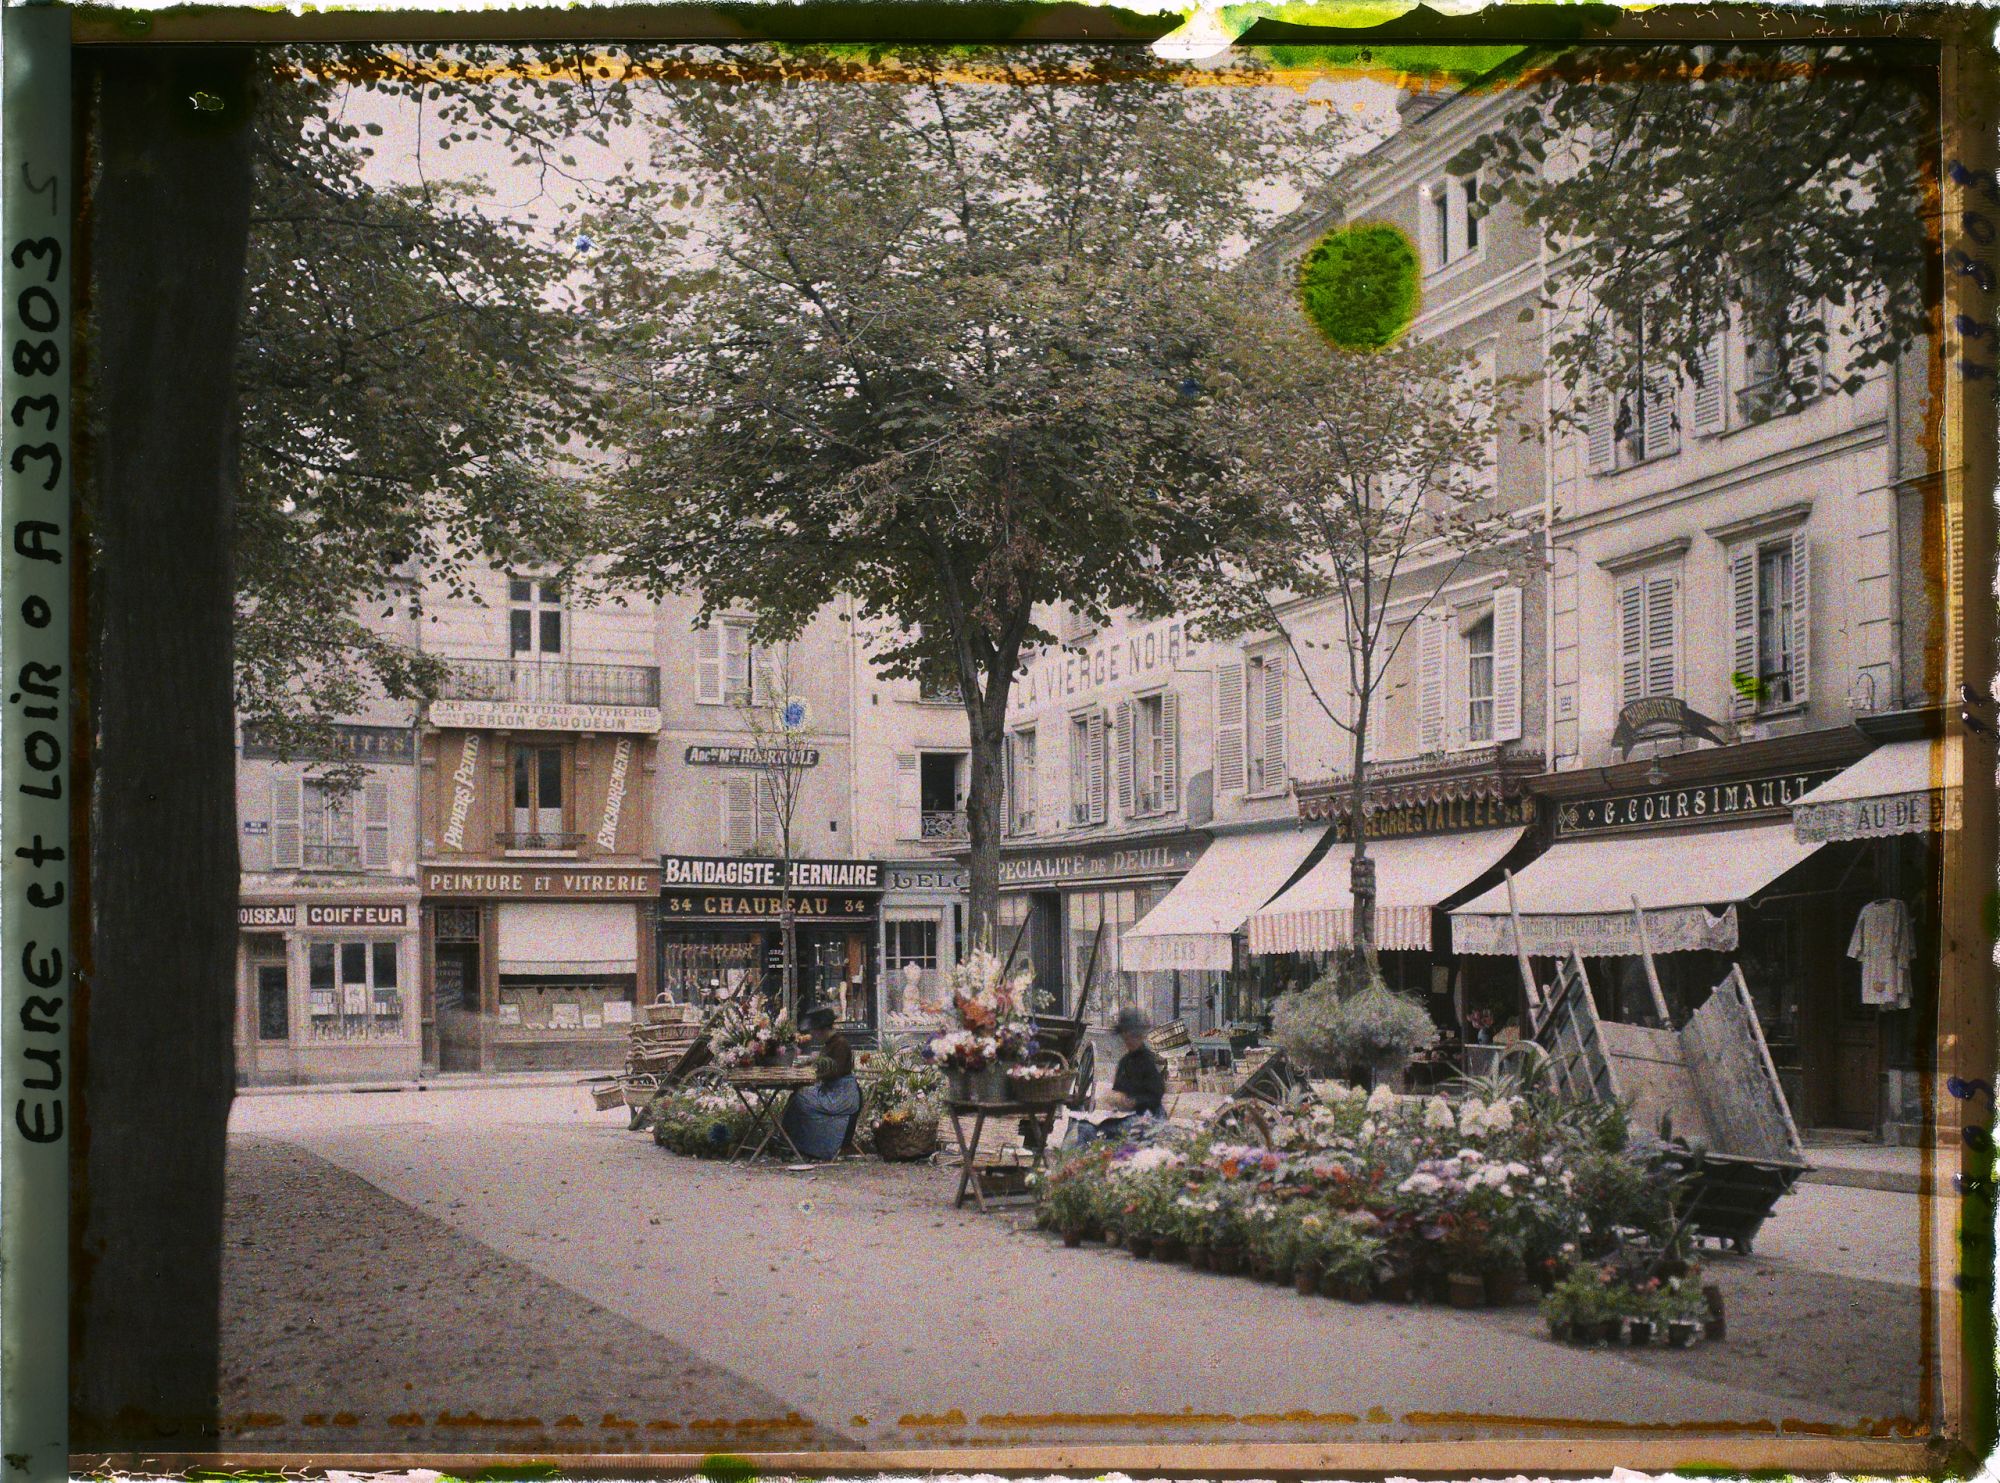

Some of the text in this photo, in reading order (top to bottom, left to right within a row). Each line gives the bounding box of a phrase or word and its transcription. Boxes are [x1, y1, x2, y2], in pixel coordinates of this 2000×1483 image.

[10, 237, 62, 491] 33803
[14, 519, 62, 565] A
[1045, 644, 1120, 697] VIERGE
[1129, 622, 1197, 676] NOIRE
[443, 733, 480, 852] PAPIERS PEINTS
[596, 737, 632, 853] ENCADREMENTS
[1363, 807, 1424, 837] GEORGES
[1857, 802, 1886, 831] AU
[15, 834, 65, 908] et
[788, 862, 878, 886] HERNIAIRE
[1113, 847, 1175, 871] DEUIL
[430, 874, 648, 892] PEINTURE ET VITRERIE
[237, 908, 295, 925] OISEAU
[310, 907, 403, 924] COIFFEUR
[670, 896, 865, 915] 34 CHAUBEAU 34
[15, 941, 63, 1144] EURE
